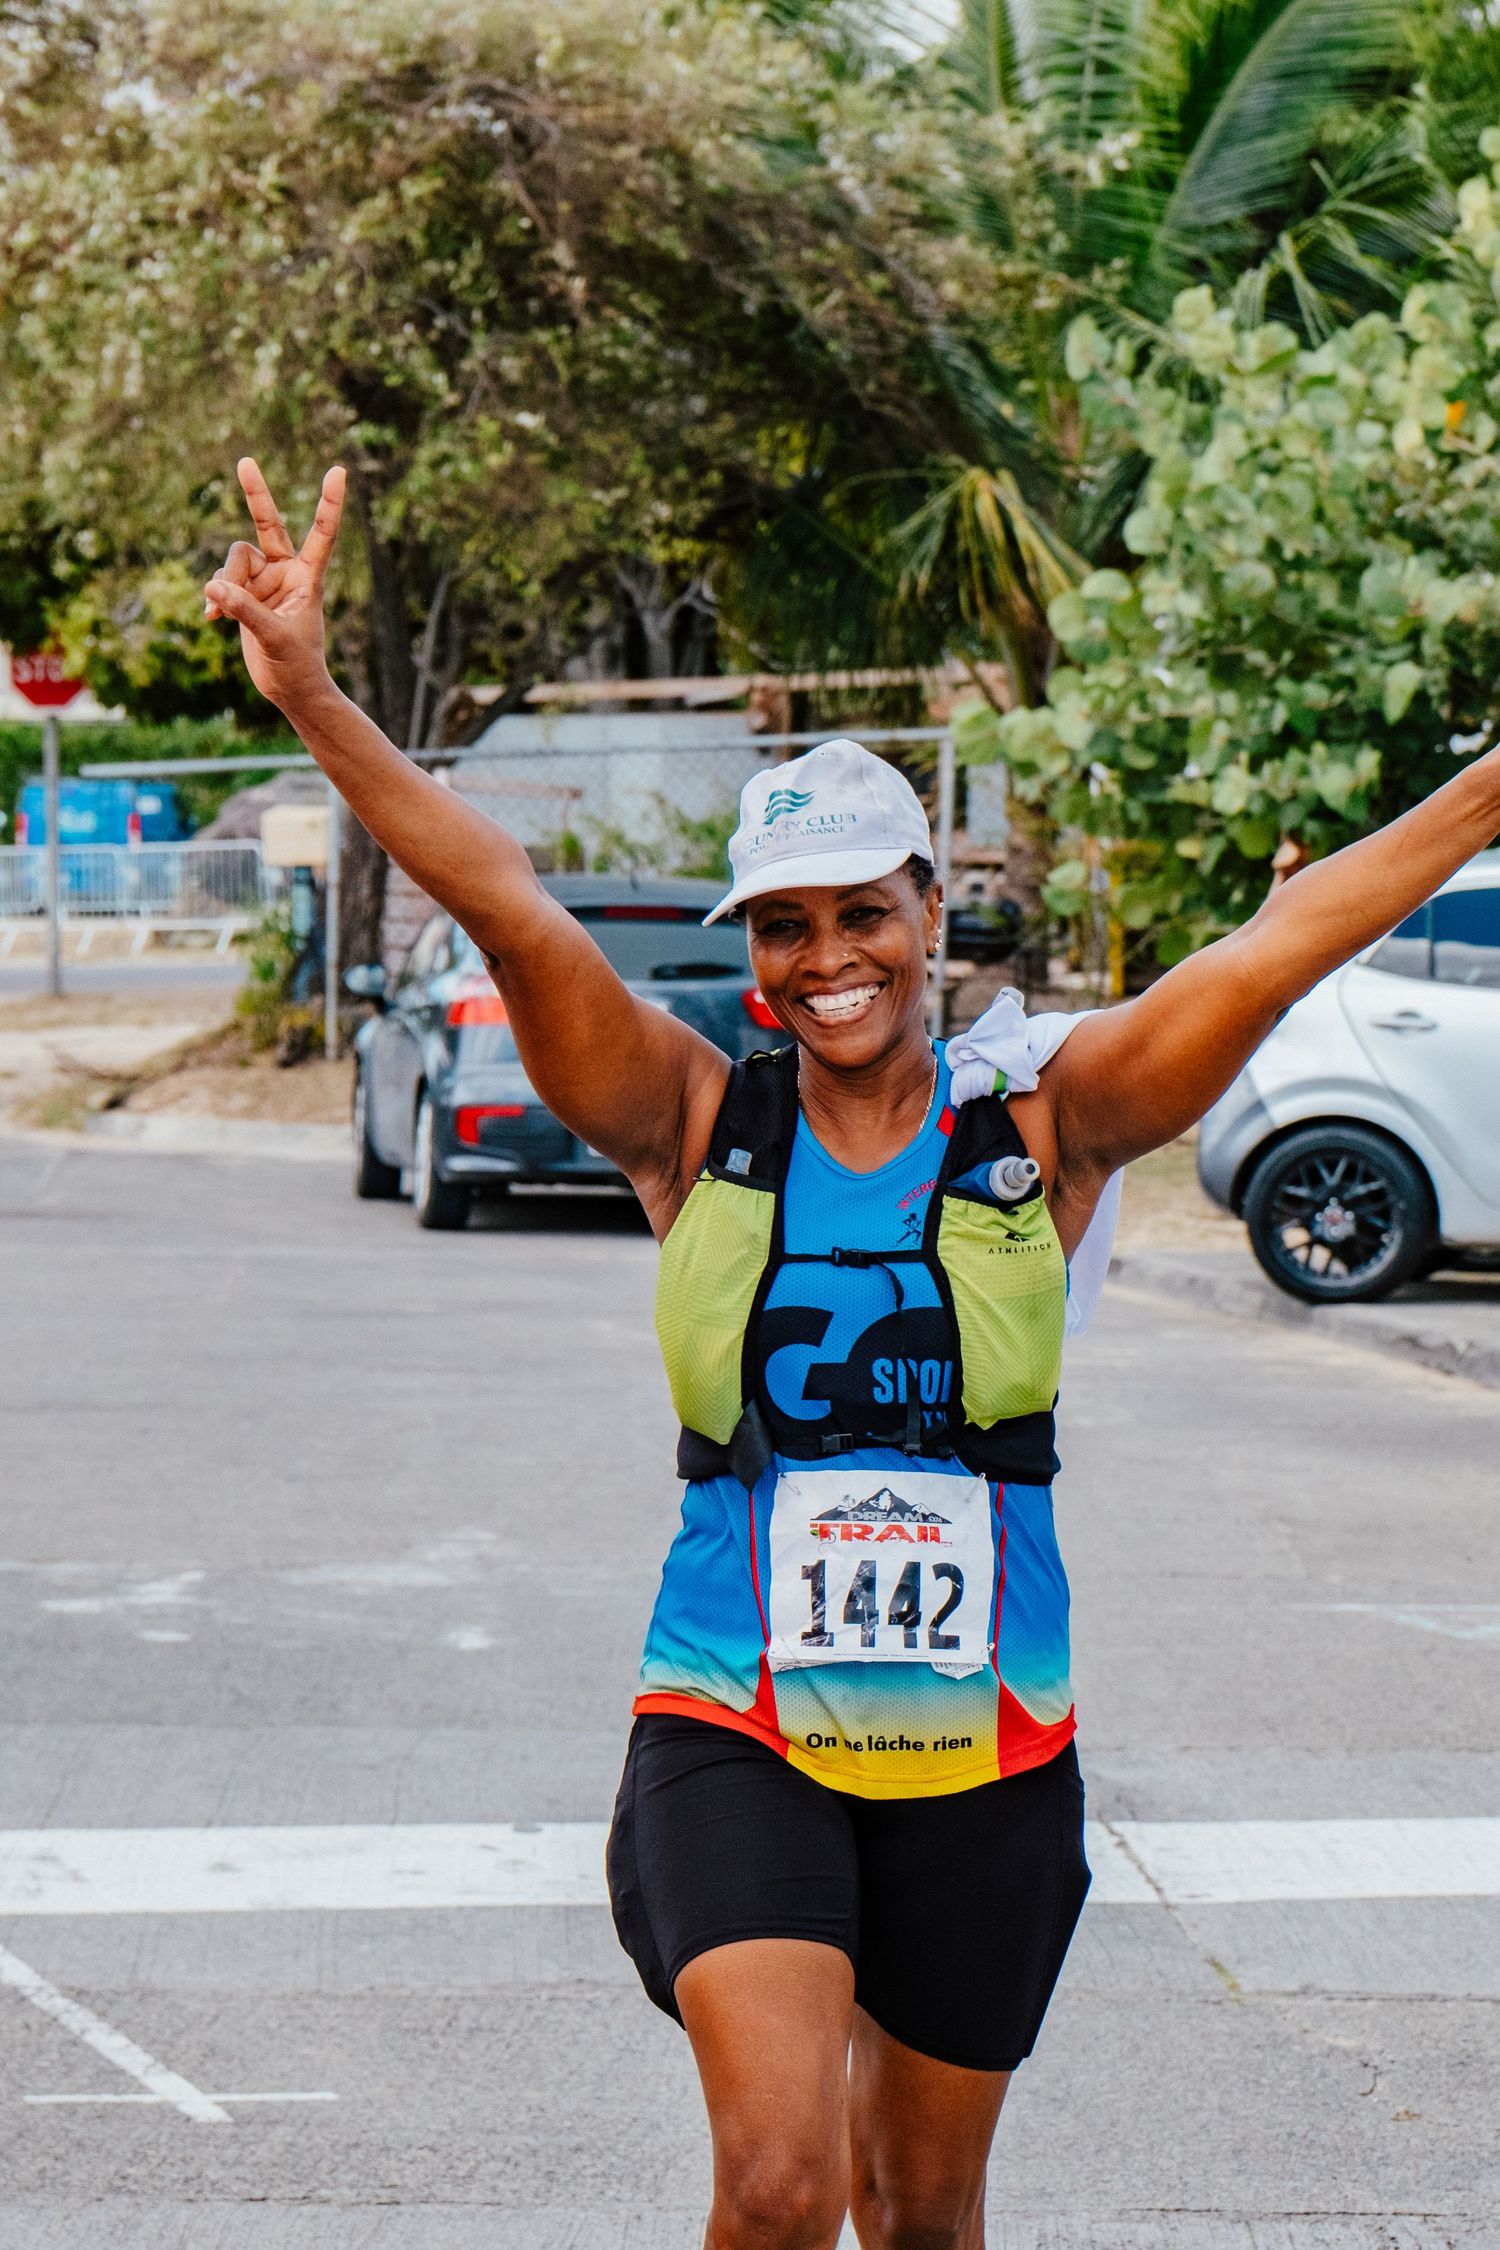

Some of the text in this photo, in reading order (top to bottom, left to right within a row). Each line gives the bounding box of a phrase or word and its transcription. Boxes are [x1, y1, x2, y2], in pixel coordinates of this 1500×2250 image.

[15, 656, 70, 683] STO
[806, 813, 857, 827] CLUB
[847, 1511, 923, 1522] DREAM
[810, 1523, 952, 1546] TRAIL
[801, 1559, 965, 1650] 1442
[806, 1733, 837, 1748] On
[868, 1734, 925, 1751] lâche
[933, 1735, 972, 1751] rien
